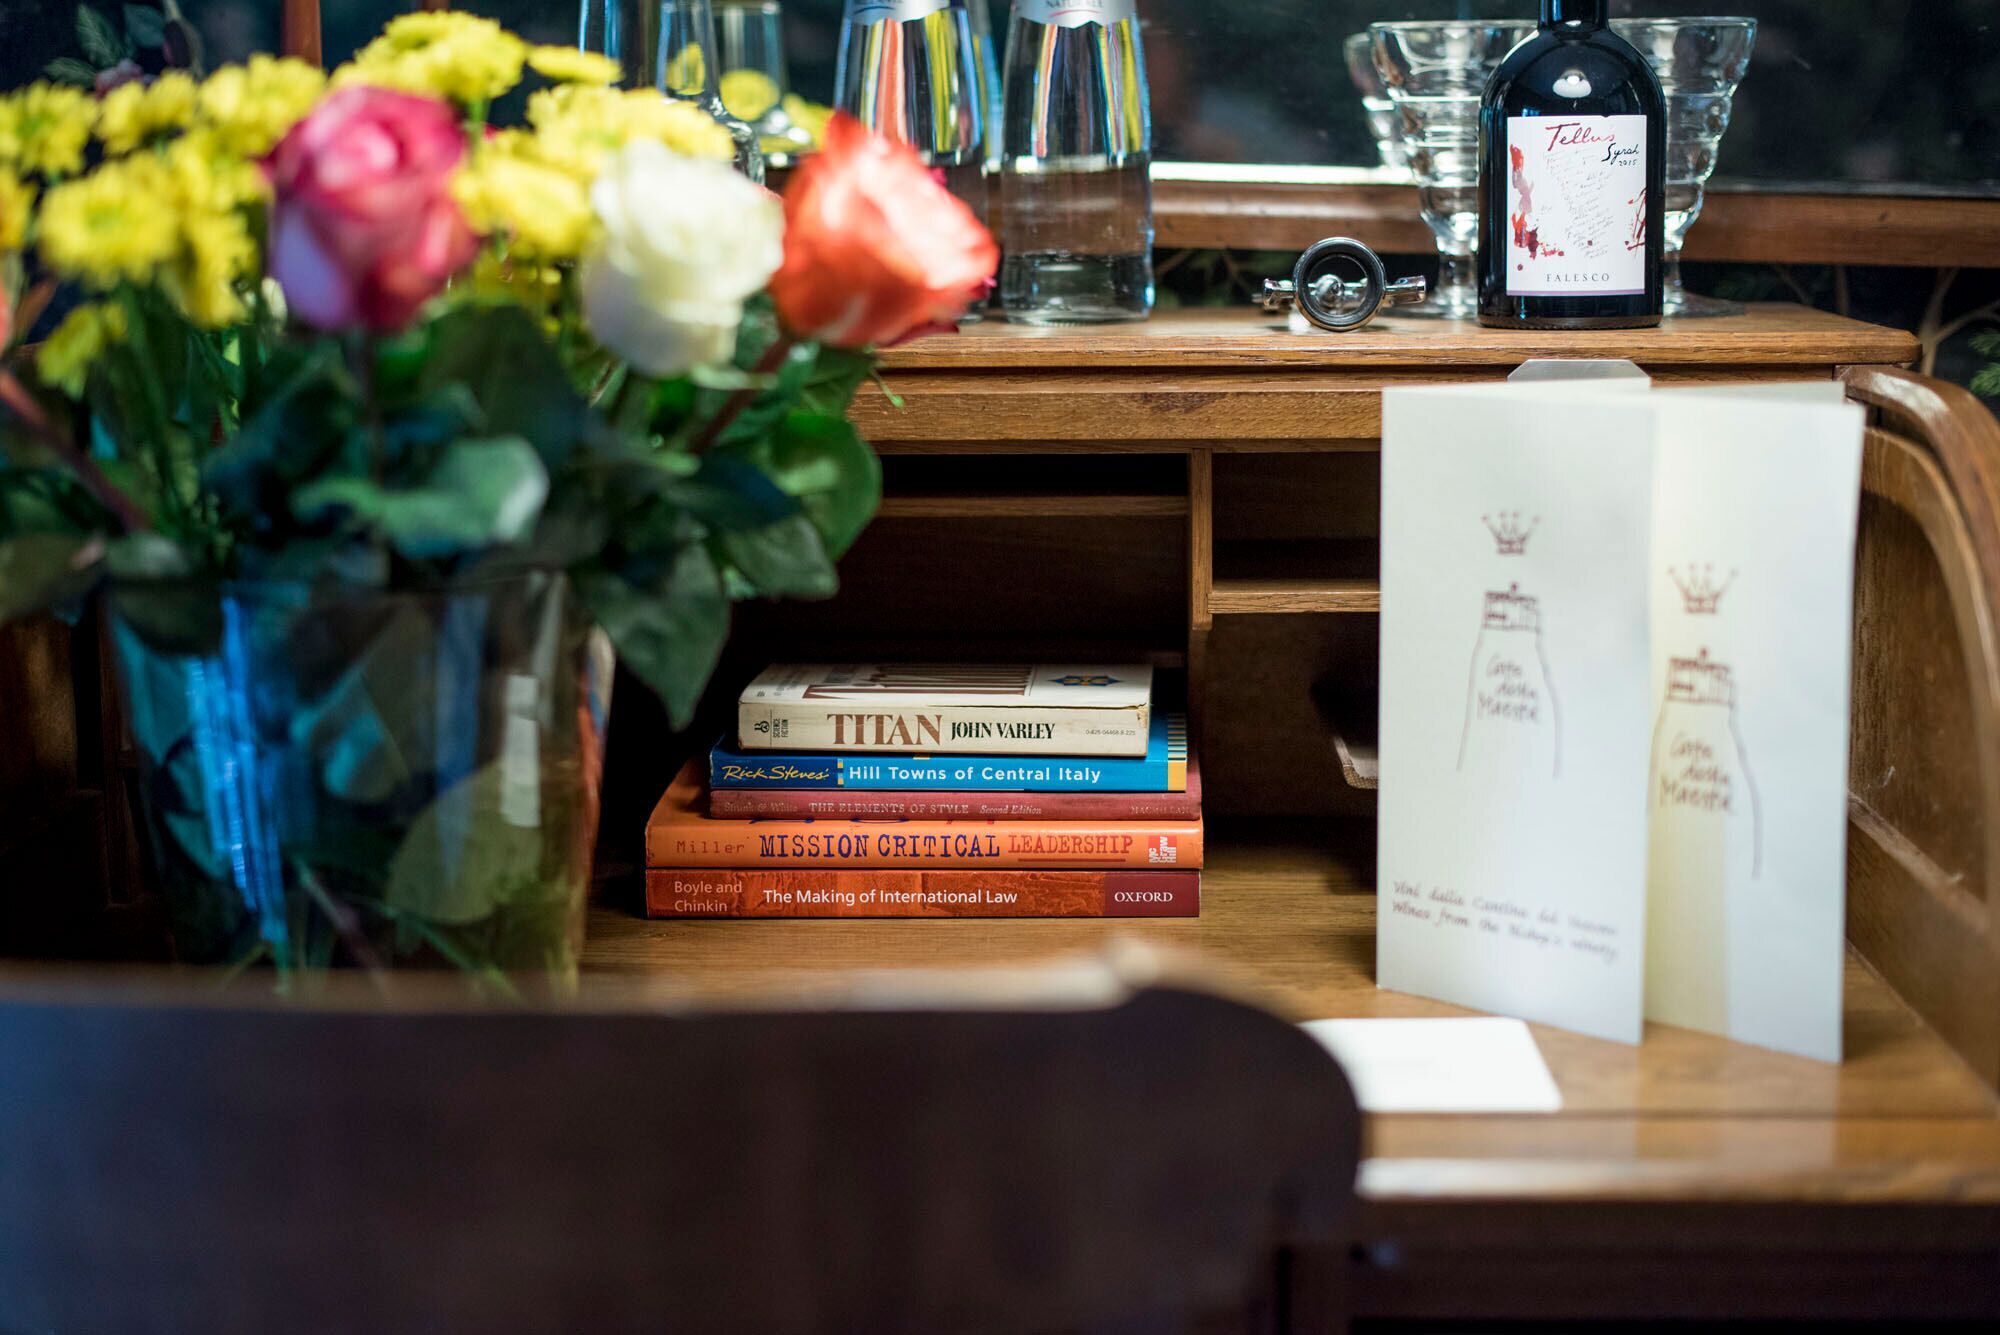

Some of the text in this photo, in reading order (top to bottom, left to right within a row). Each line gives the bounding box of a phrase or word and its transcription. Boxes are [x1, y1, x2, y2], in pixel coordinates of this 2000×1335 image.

[1545, 122, 1615, 152] Tellus
[1601, 142, 1640, 165] Syrah
[1618, 159, 1637, 167] 2015
[1546, 273, 1610, 283] FALESCO
[827, 713, 1055, 746] TITAN JOHN VARLEY
[721, 765, 830, 781] Rick Steves'
[849, 766, 1101, 784] Hill Towns of Central Italy
[808, 802, 1042, 816] THE ELEMENTS OF STYLE Second Edition
[676, 833, 1133, 858] Miller MISSION CRITICAL LEADERSHIP
[674, 881, 743, 896] Boyle and
[763, 889, 1018, 907] The Making of International Law
[1114, 891, 1174, 903] OXFORD
[674, 899, 729, 913] Chinkin
